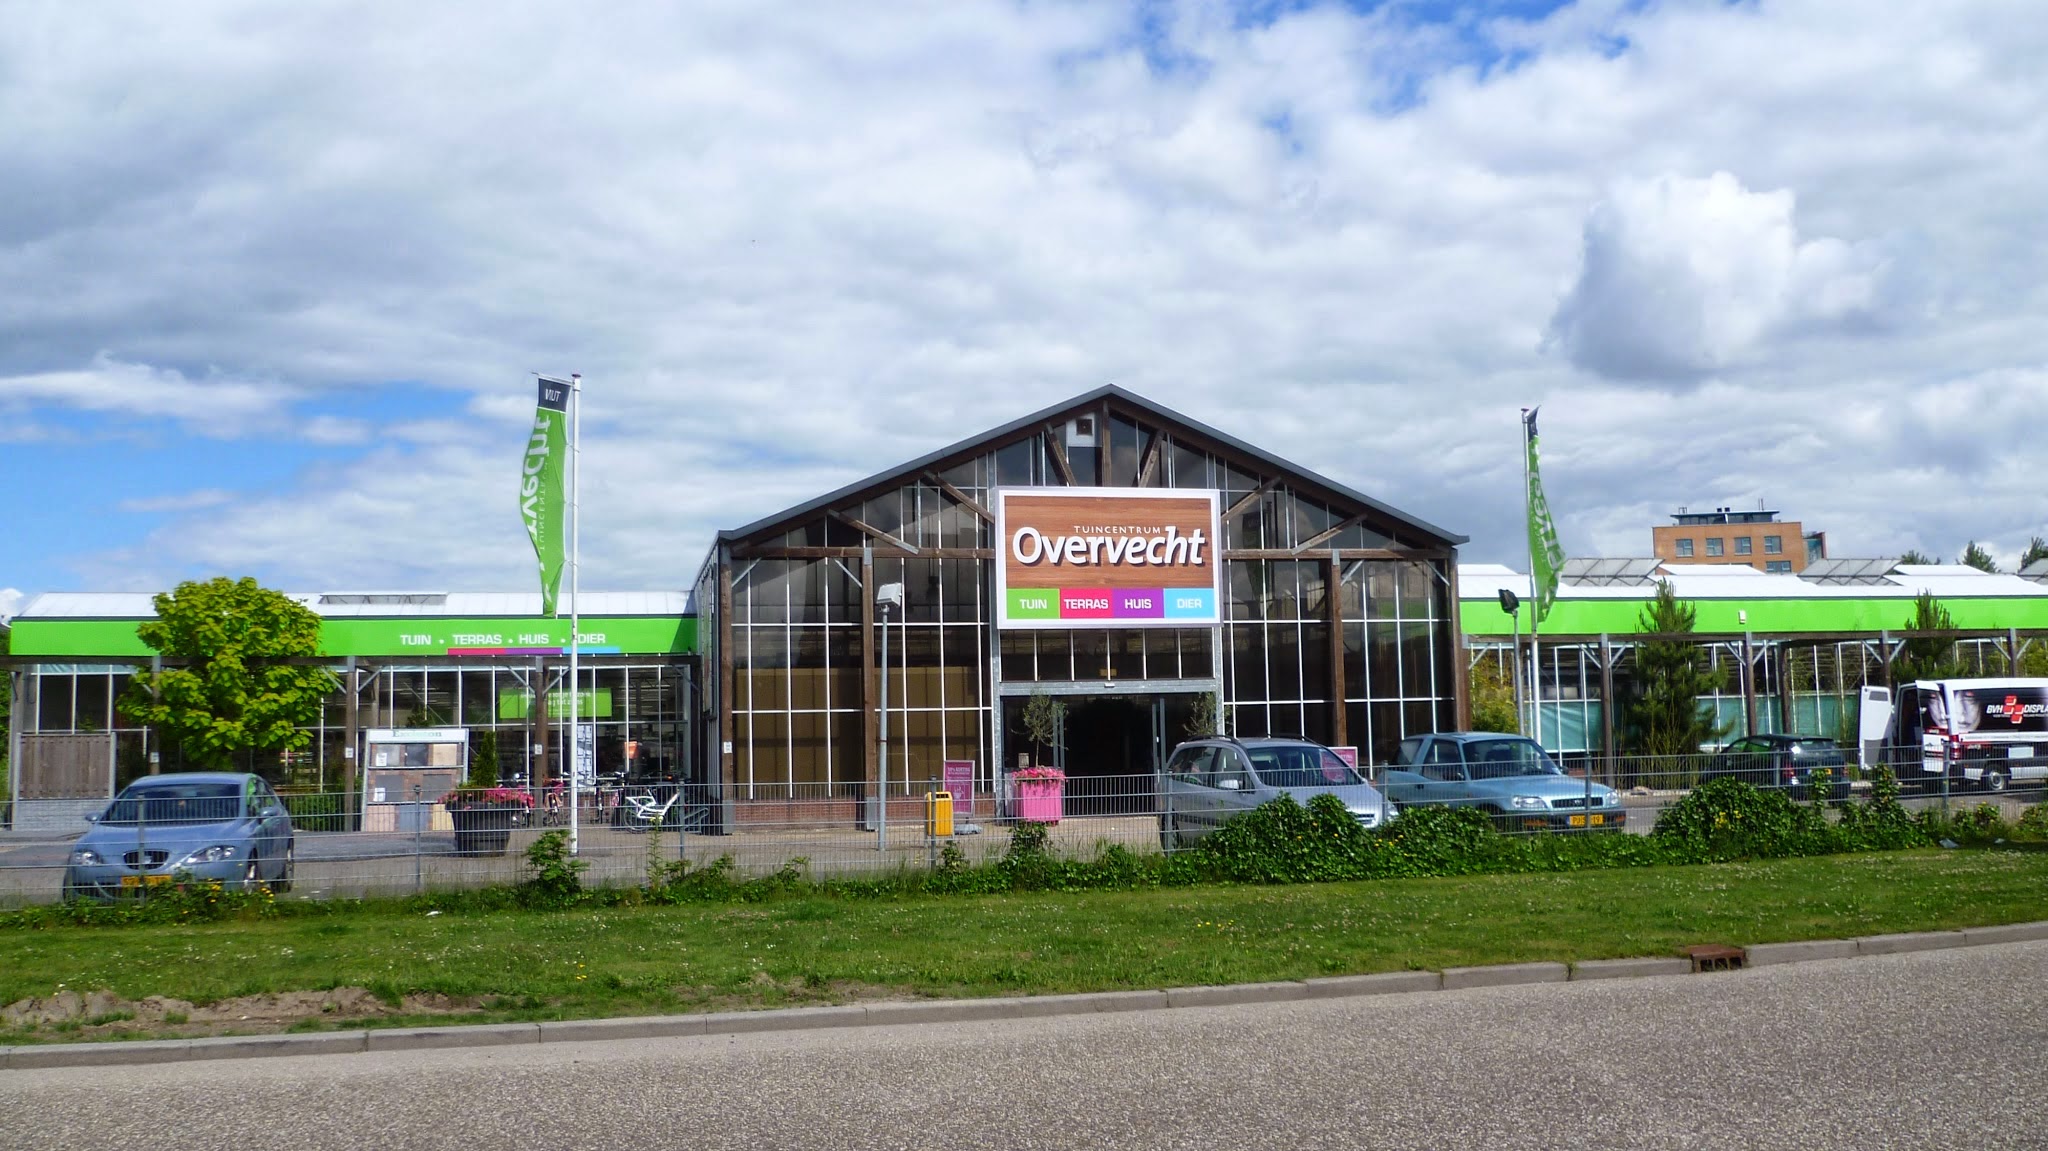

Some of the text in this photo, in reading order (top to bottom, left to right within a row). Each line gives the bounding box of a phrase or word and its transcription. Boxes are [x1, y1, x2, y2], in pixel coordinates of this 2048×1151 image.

[1073, 525, 1161, 534] TUINCENTRUM
[1012, 525, 1206, 564] Overvecht
[1019, 598, 1203, 609] TUIN TERRAS HUIS DIER
[400, 633, 606, 645] TUIN TERRAS HUIS DIER
[1986, 704, 2004, 714] BVH
